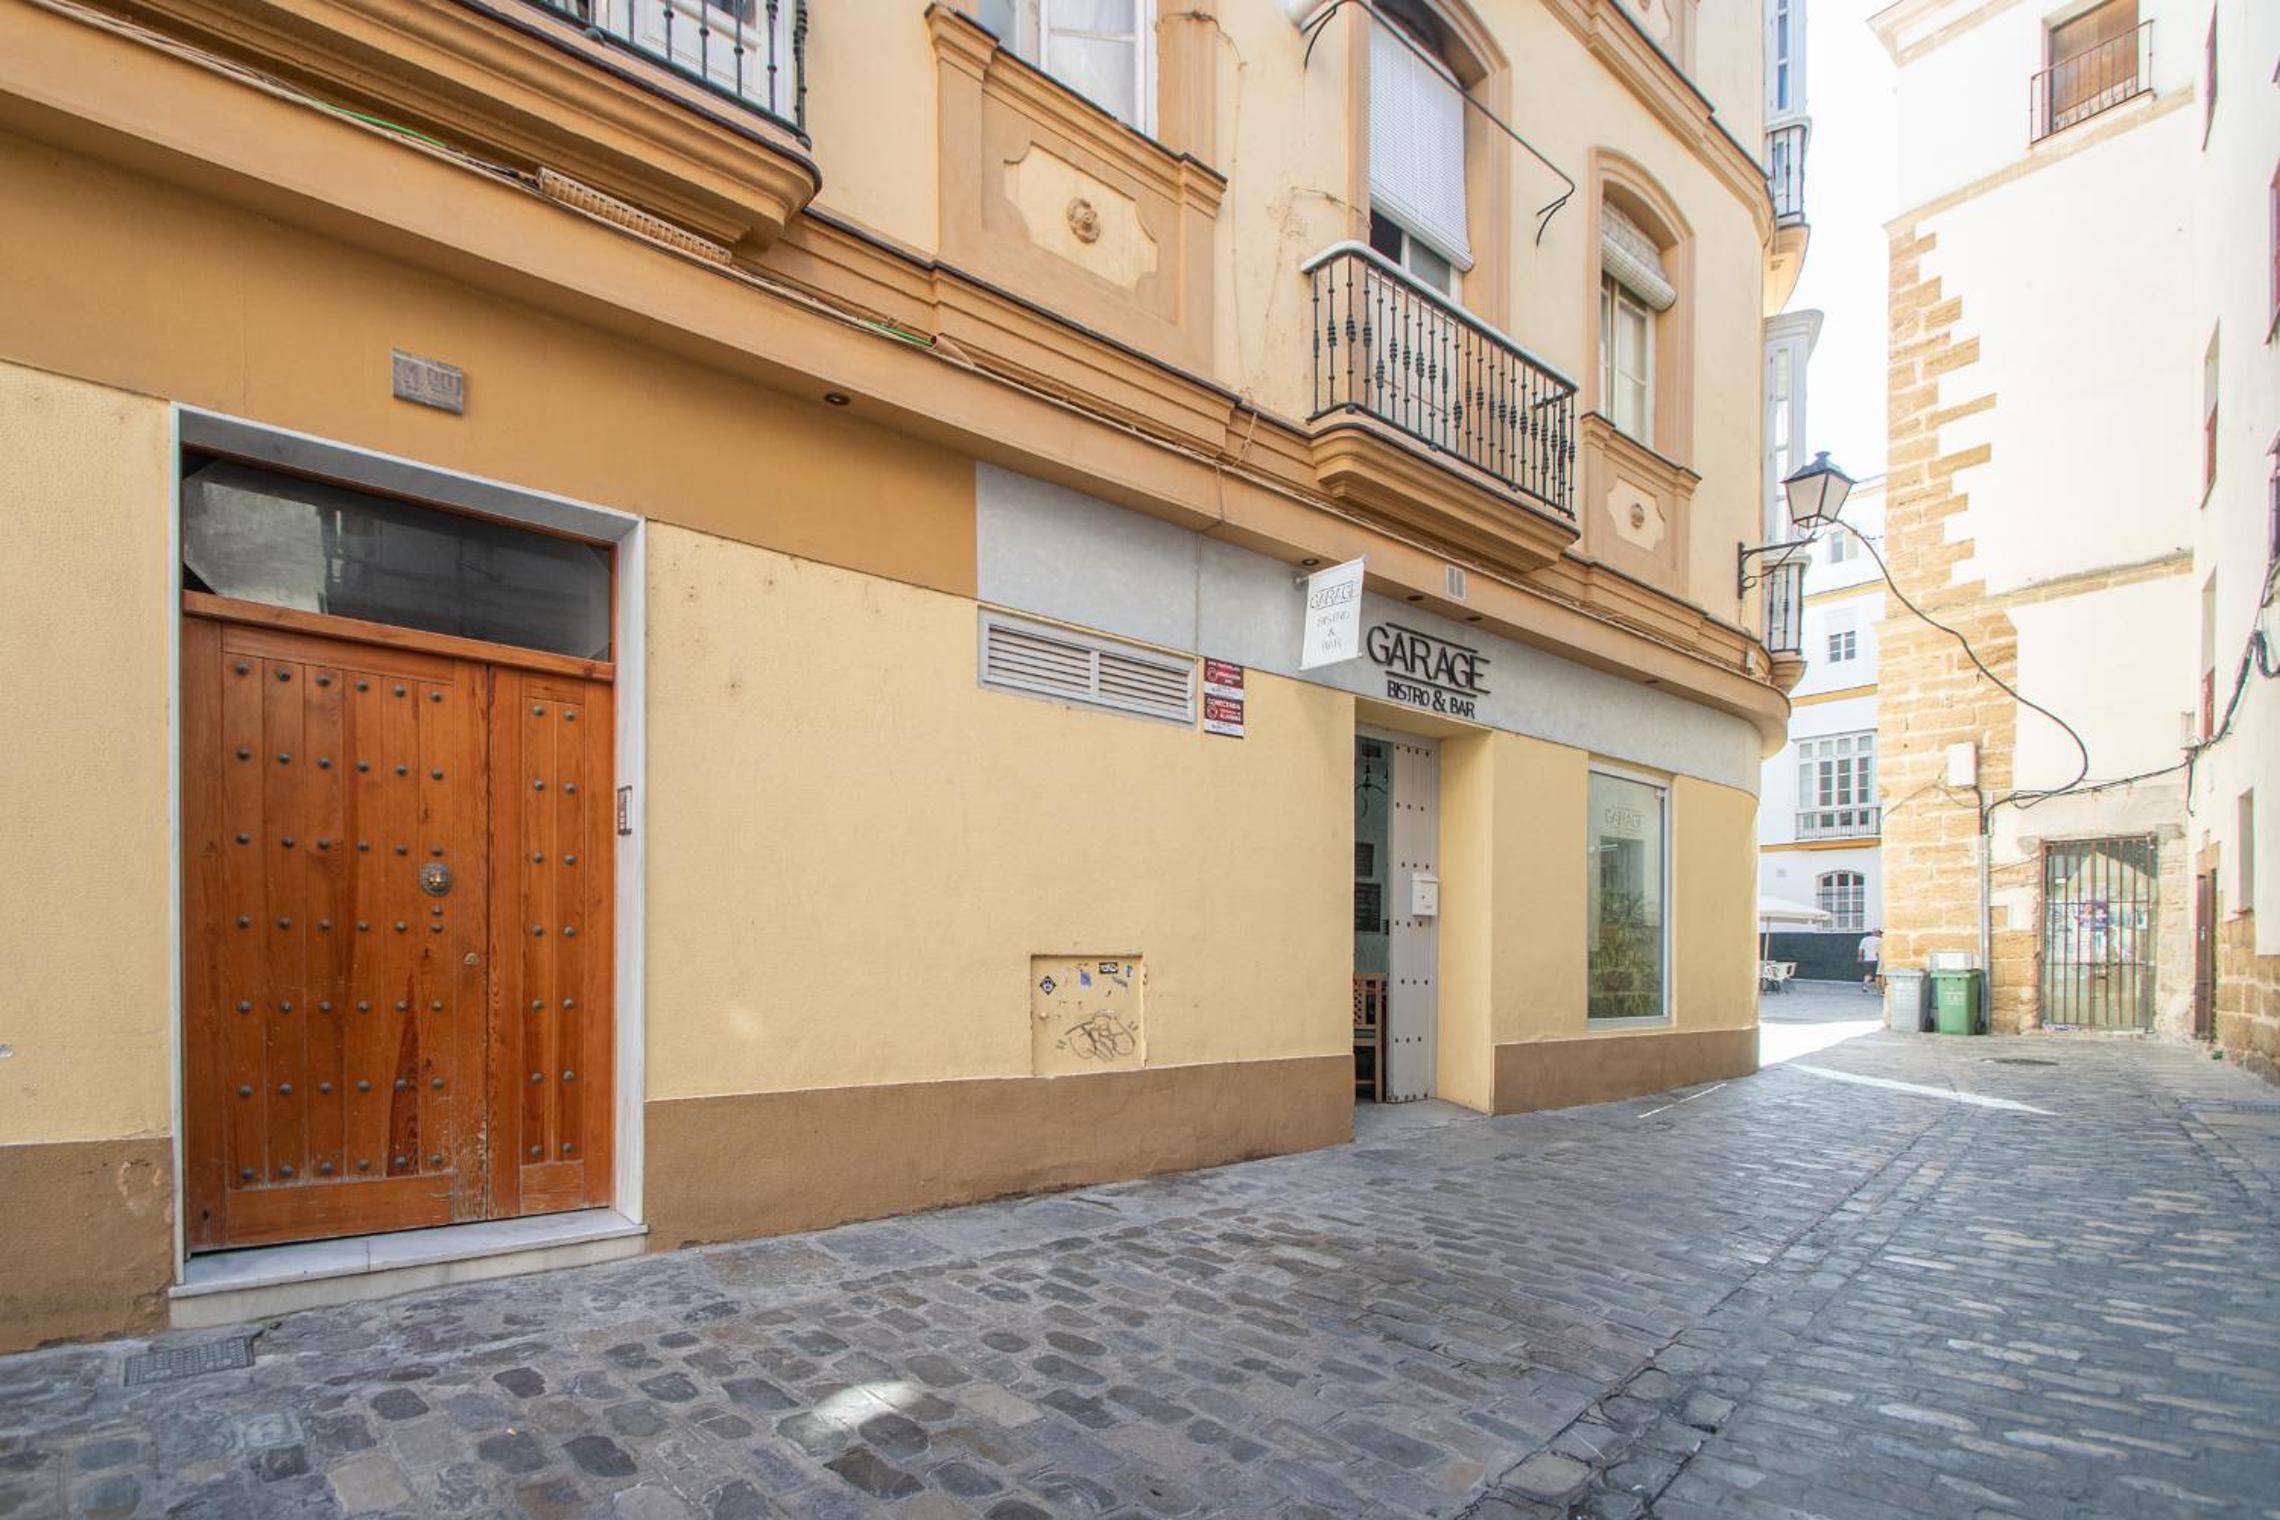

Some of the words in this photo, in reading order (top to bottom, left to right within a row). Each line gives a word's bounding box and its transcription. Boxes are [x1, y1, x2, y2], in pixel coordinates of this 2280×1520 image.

[1367, 626, 1491, 694] GARAGE
[1387, 680, 1430, 707] BISTRO
[1432, 690, 1447, 713] &
[1450, 697, 1475, 719] BAR
